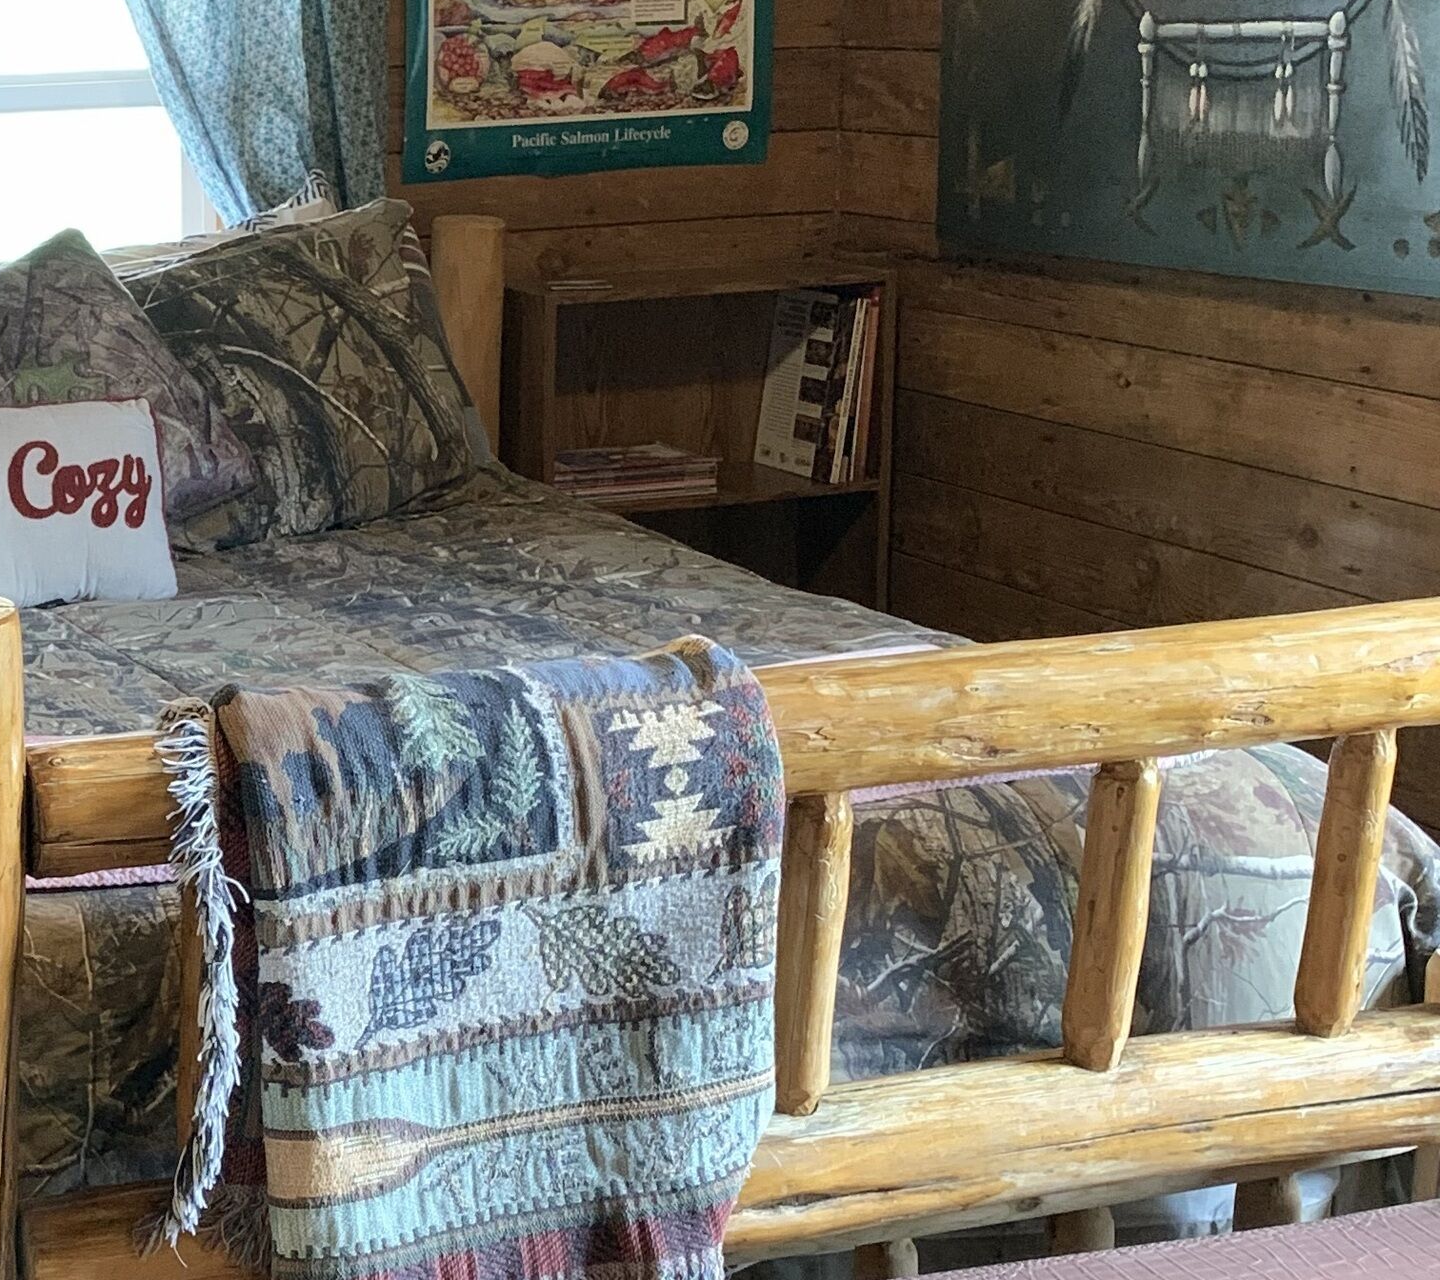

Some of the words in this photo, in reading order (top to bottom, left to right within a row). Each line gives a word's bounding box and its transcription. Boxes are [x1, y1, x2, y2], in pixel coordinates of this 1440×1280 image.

[512, 132, 557, 149] Pacific
[560, 130, 610, 146] Salmon
[614, 124, 672, 143] Lifecycle
[8, 440, 153, 529] Cozy
